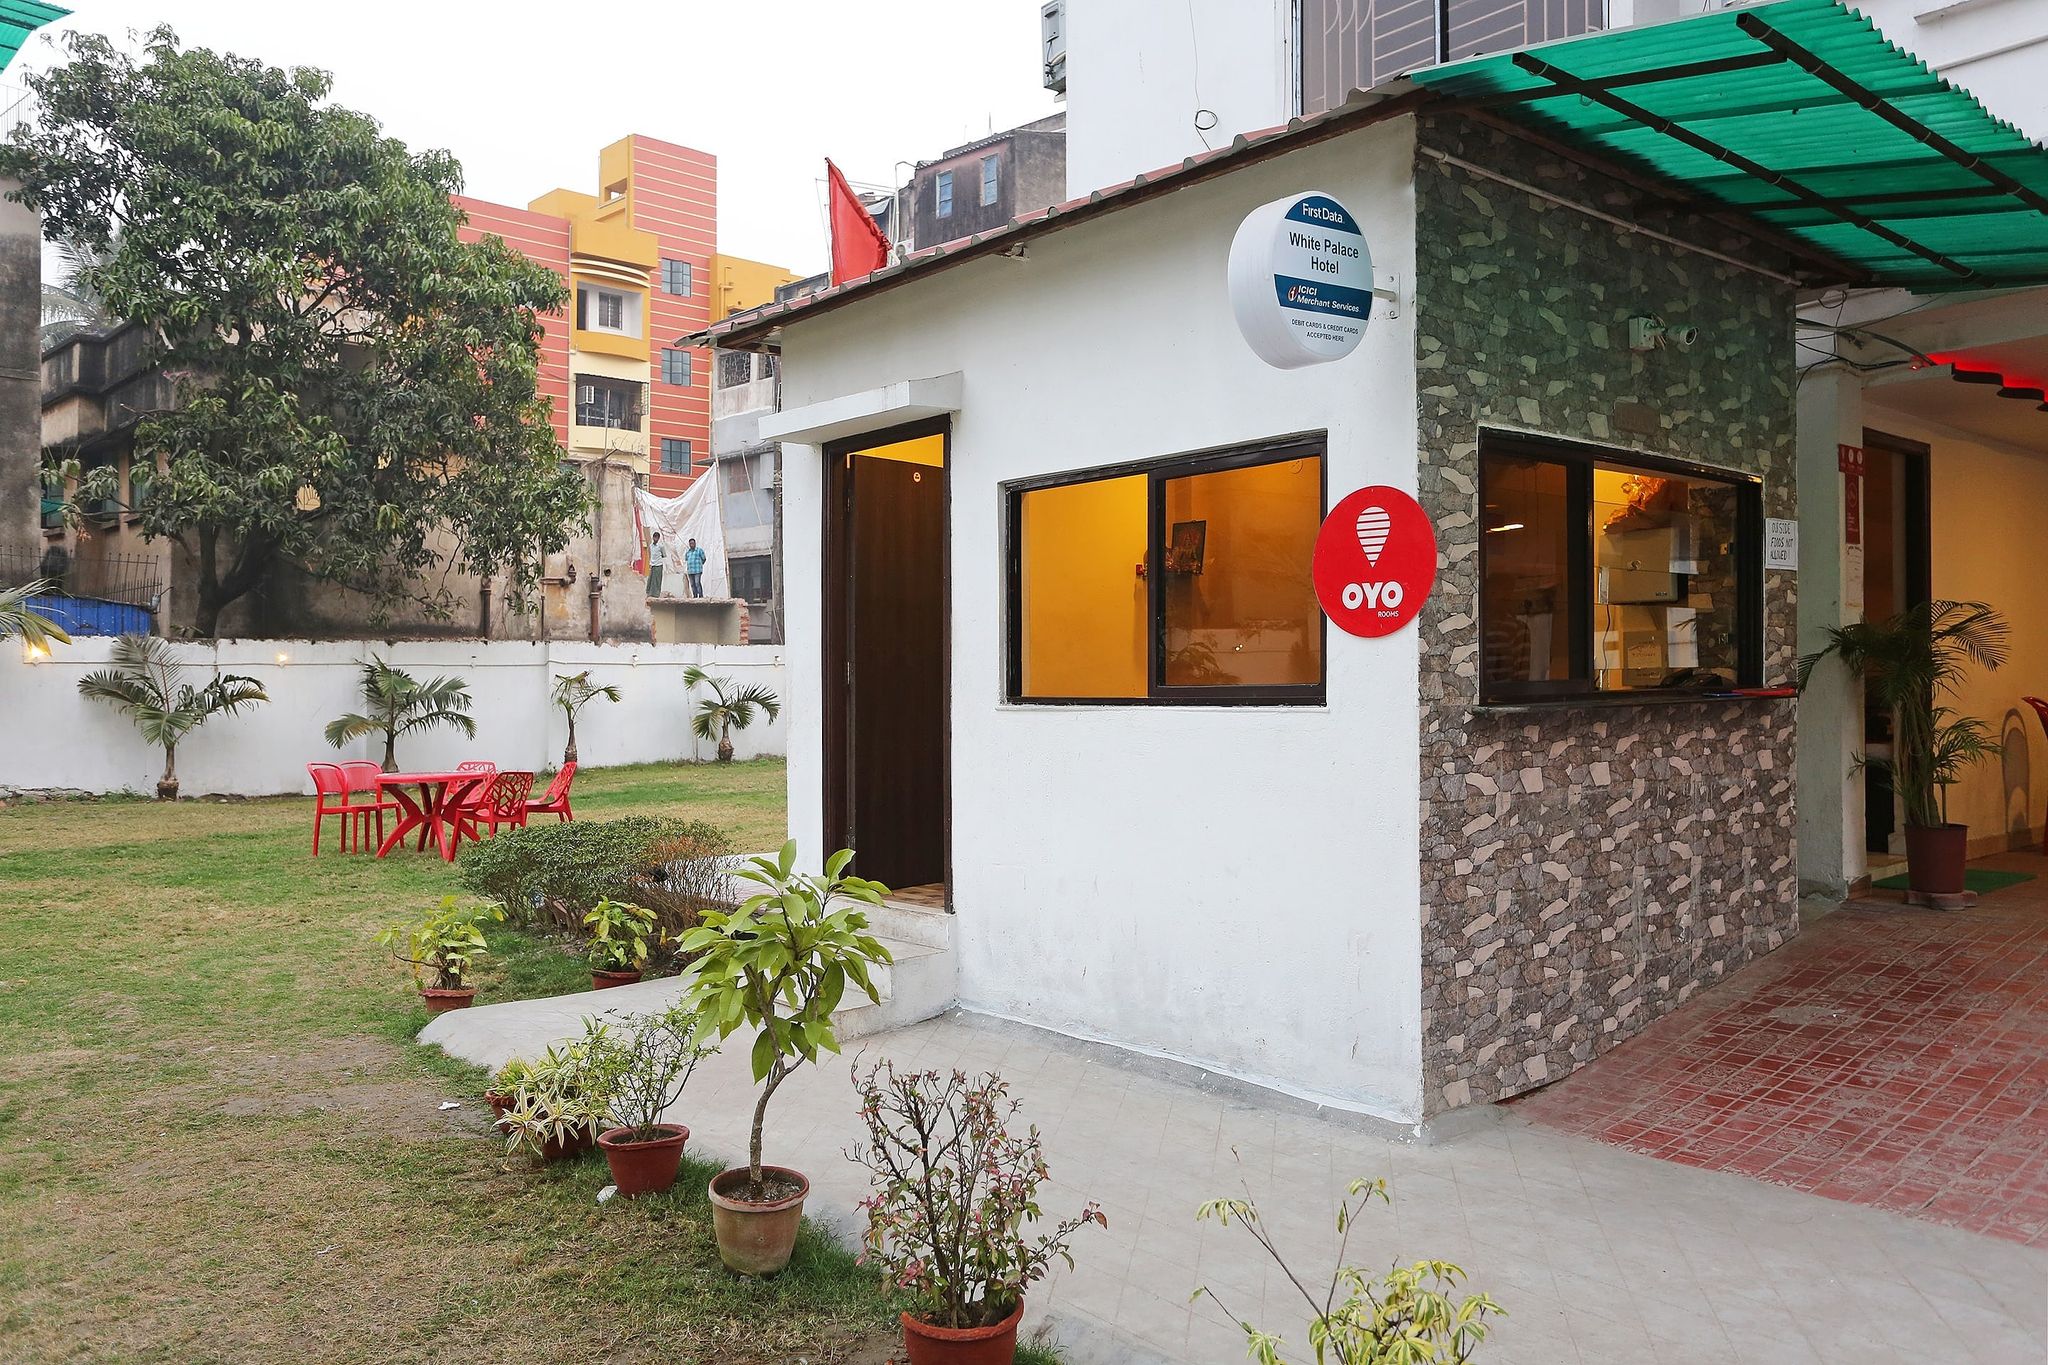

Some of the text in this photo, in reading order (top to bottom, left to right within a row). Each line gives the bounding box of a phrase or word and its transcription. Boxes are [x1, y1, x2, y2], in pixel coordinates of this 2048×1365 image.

[1289, 231, 1359, 259] White Palace
[1311, 256, 1339, 274] Hotel
[1298, 285, 1318, 296] ICICI
[1296, 295, 1360, 312] Merchant Services
[1291, 318, 1305, 327] DEBIT
[1305, 320, 1322, 329] CARDS
[1326, 324, 1343, 332] CREDIT
[1343, 326, 1359, 335] CARDS
[1306, 331, 1332, 341] ACCEPTED
[1342, 581, 1403, 609] OYO
